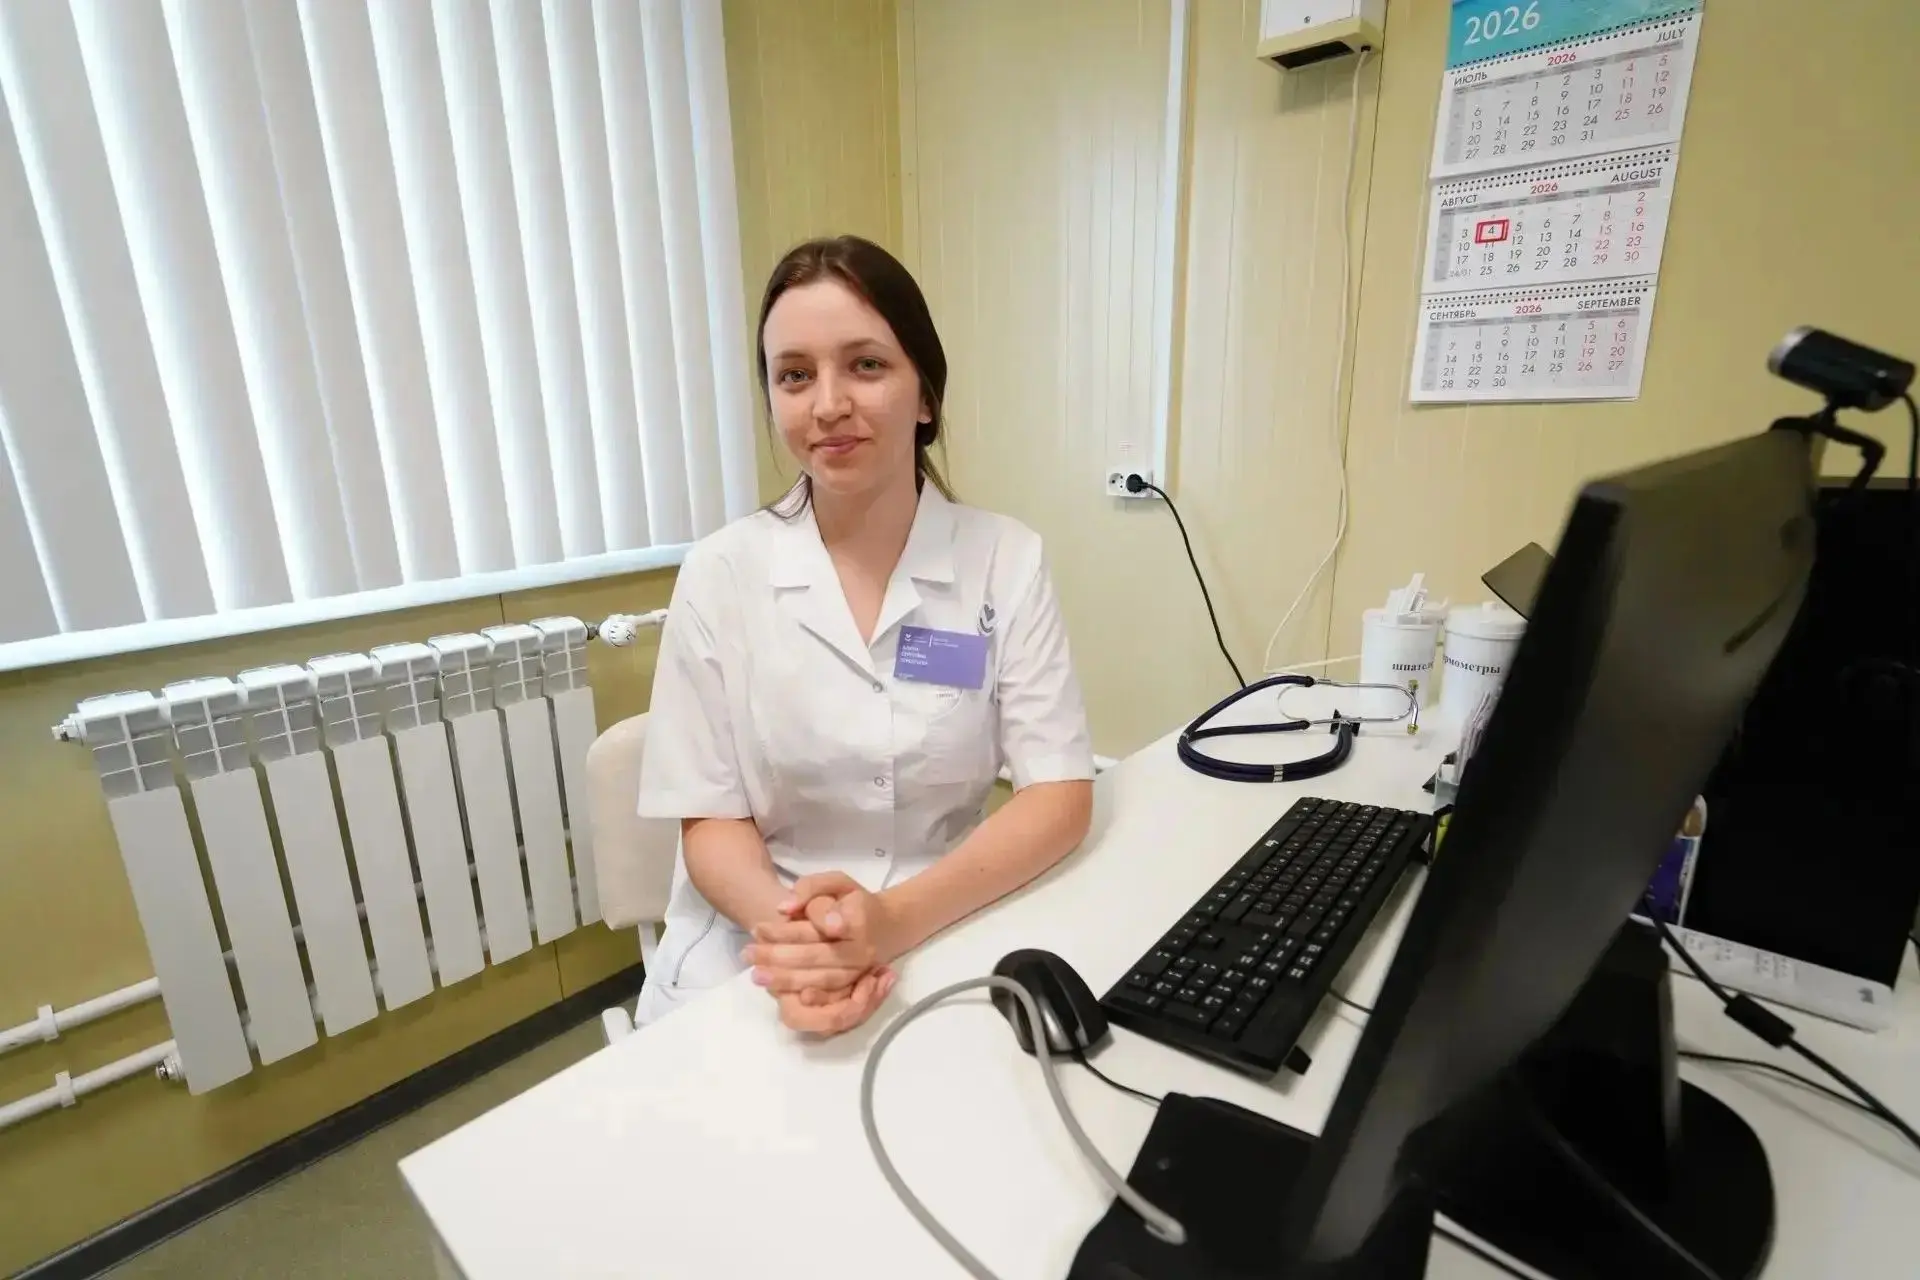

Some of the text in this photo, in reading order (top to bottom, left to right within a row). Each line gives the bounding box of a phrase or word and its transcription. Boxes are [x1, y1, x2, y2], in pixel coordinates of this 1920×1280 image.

[1464, 0, 1540, 45] 2026
[1656, 28, 1686, 43] JULY
[1547, 52, 1576, 66] 2026
[1454, 71, 1487, 86] ИЮЛЬ
[1534, 55, 1668, 90] 1 2 3 4 5
[1474, 71, 1670, 116] 6 7 8 9 10 11 12
[1472, 86, 1666, 130] 13 14 15 16 17 18 19
[1467, 103, 1663, 145] 20 21 22 23 24 25 26
[1466, 130, 1594, 159] 27 28 29 30 31
[1611, 167, 1663, 183] AUGUST
[1531, 182, 1558, 194] 2026
[1441, 194, 1478, 207] АВГУСТ
[1607, 191, 1646, 205] 1 2
[1462, 207, 1643, 238] 3 4 5 6 7 8 9
[1459, 242, 1470, 252] 10
[1512, 235, 1523, 245] 12
[1540, 232, 1552, 242] 13
[1569, 229, 1581, 238] 14
[1600, 225, 1612, 235] 15
[1631, 222, 1644, 232] 16
[1457, 236, 1642, 265] 17 18 19 20 21 22 23
[1480, 266, 1492, 275] 25
[1507, 264, 1519, 273] 26
[1534, 260, 1548, 270] 27
[1563, 257, 1577, 267] 28
[1593, 253, 1608, 264] 29
[1624, 251, 1639, 261] 30
[1515, 305, 1542, 314] 2026
[1577, 296, 1641, 310] SEPTEMBER
[1430, 310, 1476, 320] СЕНТЯБРЬ
[1503, 326, 1510, 335] 2
[1530, 324, 1537, 333] 3
[1558, 323, 1565, 331] 4
[1588, 320, 1595, 330] 5
[1618, 319, 1625, 328] 6
[1449, 332, 1627, 350] 7 8 9 10 11 12 13
[1446, 346, 1625, 363] 14 15 16 17 18 19 20
[1443, 360, 1623, 376] 21 22 23 24 25 26 27
[1442, 378, 1506, 388] 28 29 30
[1443, 655, 1500, 675] рмометры
